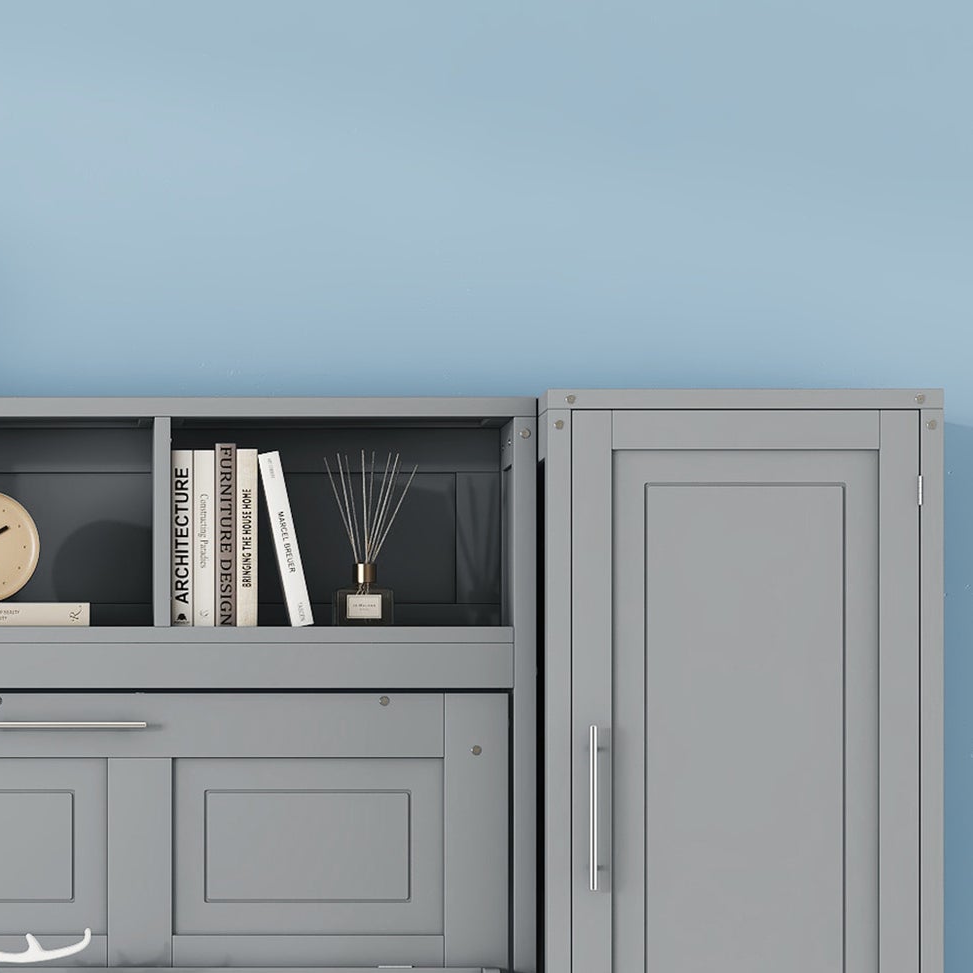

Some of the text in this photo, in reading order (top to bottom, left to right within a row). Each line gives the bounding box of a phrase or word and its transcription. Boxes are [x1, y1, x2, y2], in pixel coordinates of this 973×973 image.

[174, 467, 189, 604] ARCHITECTURE
[219, 447, 232, 626] FURNITURE DESIGN
[242, 488, 252, 588] BRINGING THE HOUSE HOME
[278, 511, 296, 573] MARCEL BREUER
